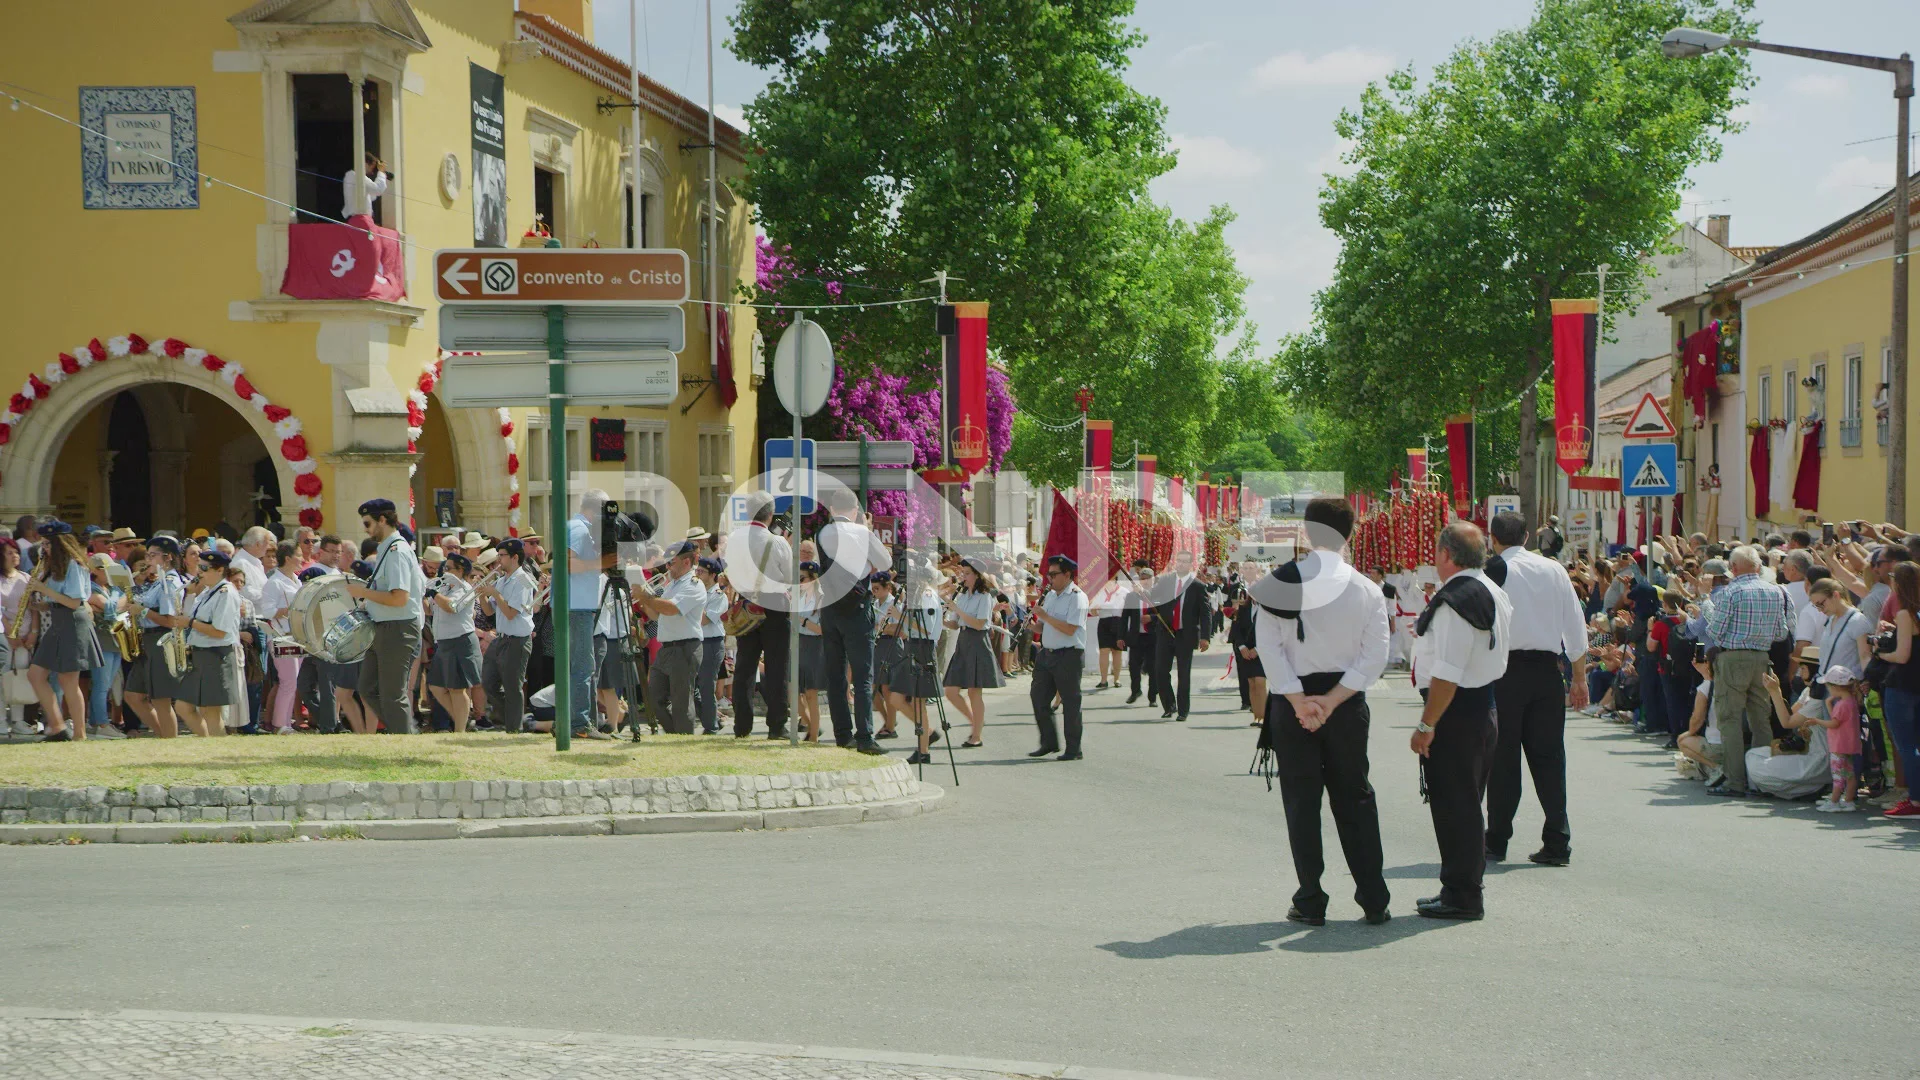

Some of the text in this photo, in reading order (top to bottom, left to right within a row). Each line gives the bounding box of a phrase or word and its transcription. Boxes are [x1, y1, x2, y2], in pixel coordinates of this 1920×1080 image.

[523, 269, 682, 285] convento de Cristo
